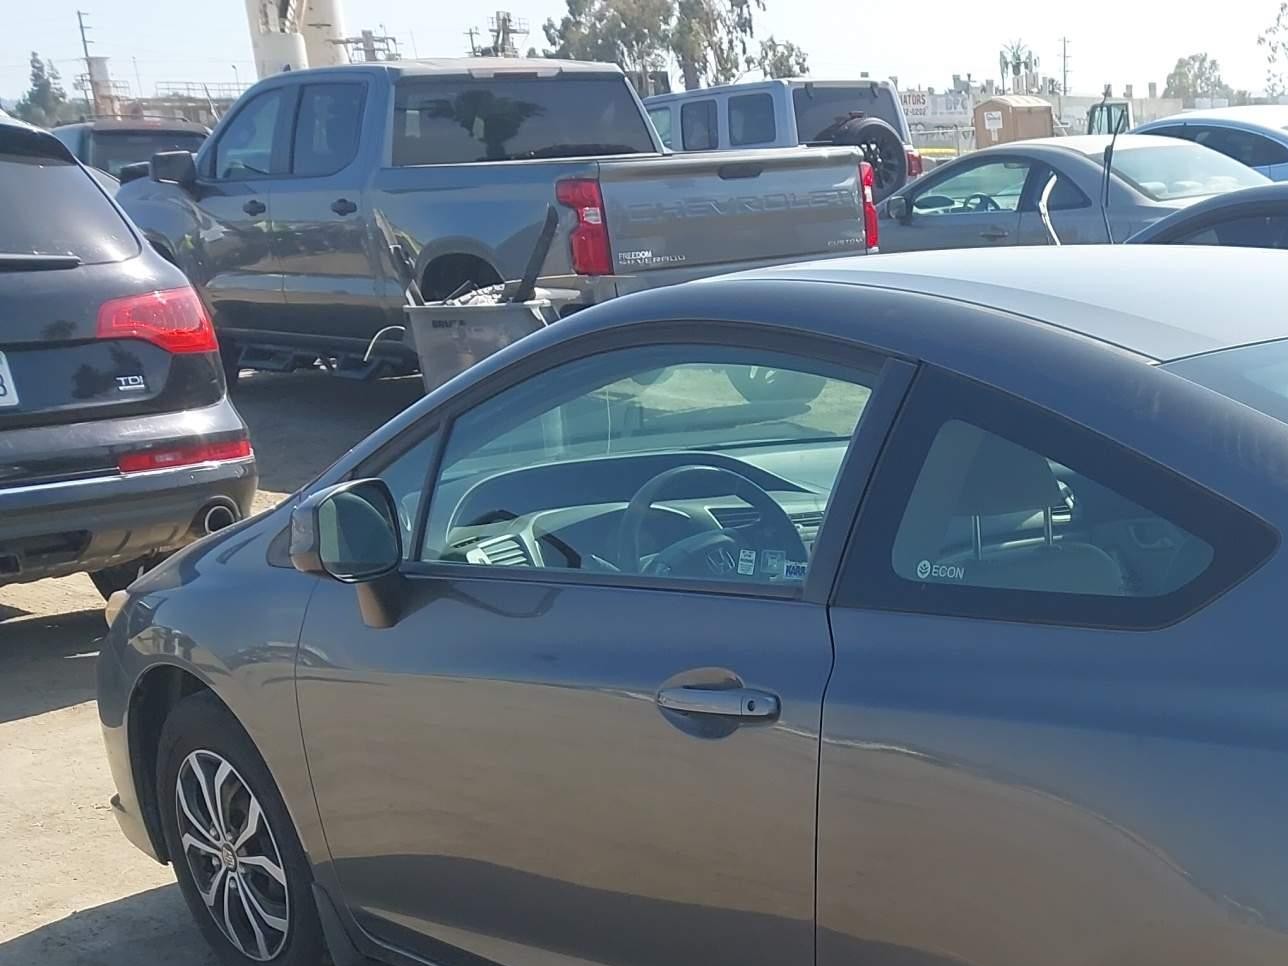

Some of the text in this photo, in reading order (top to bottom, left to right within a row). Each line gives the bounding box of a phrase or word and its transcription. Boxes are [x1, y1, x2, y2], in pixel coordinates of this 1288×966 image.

[618, 250, 653, 261] FREEDOM
[116, 375, 144, 387] TDI
[931, 567, 965, 580] ECON
